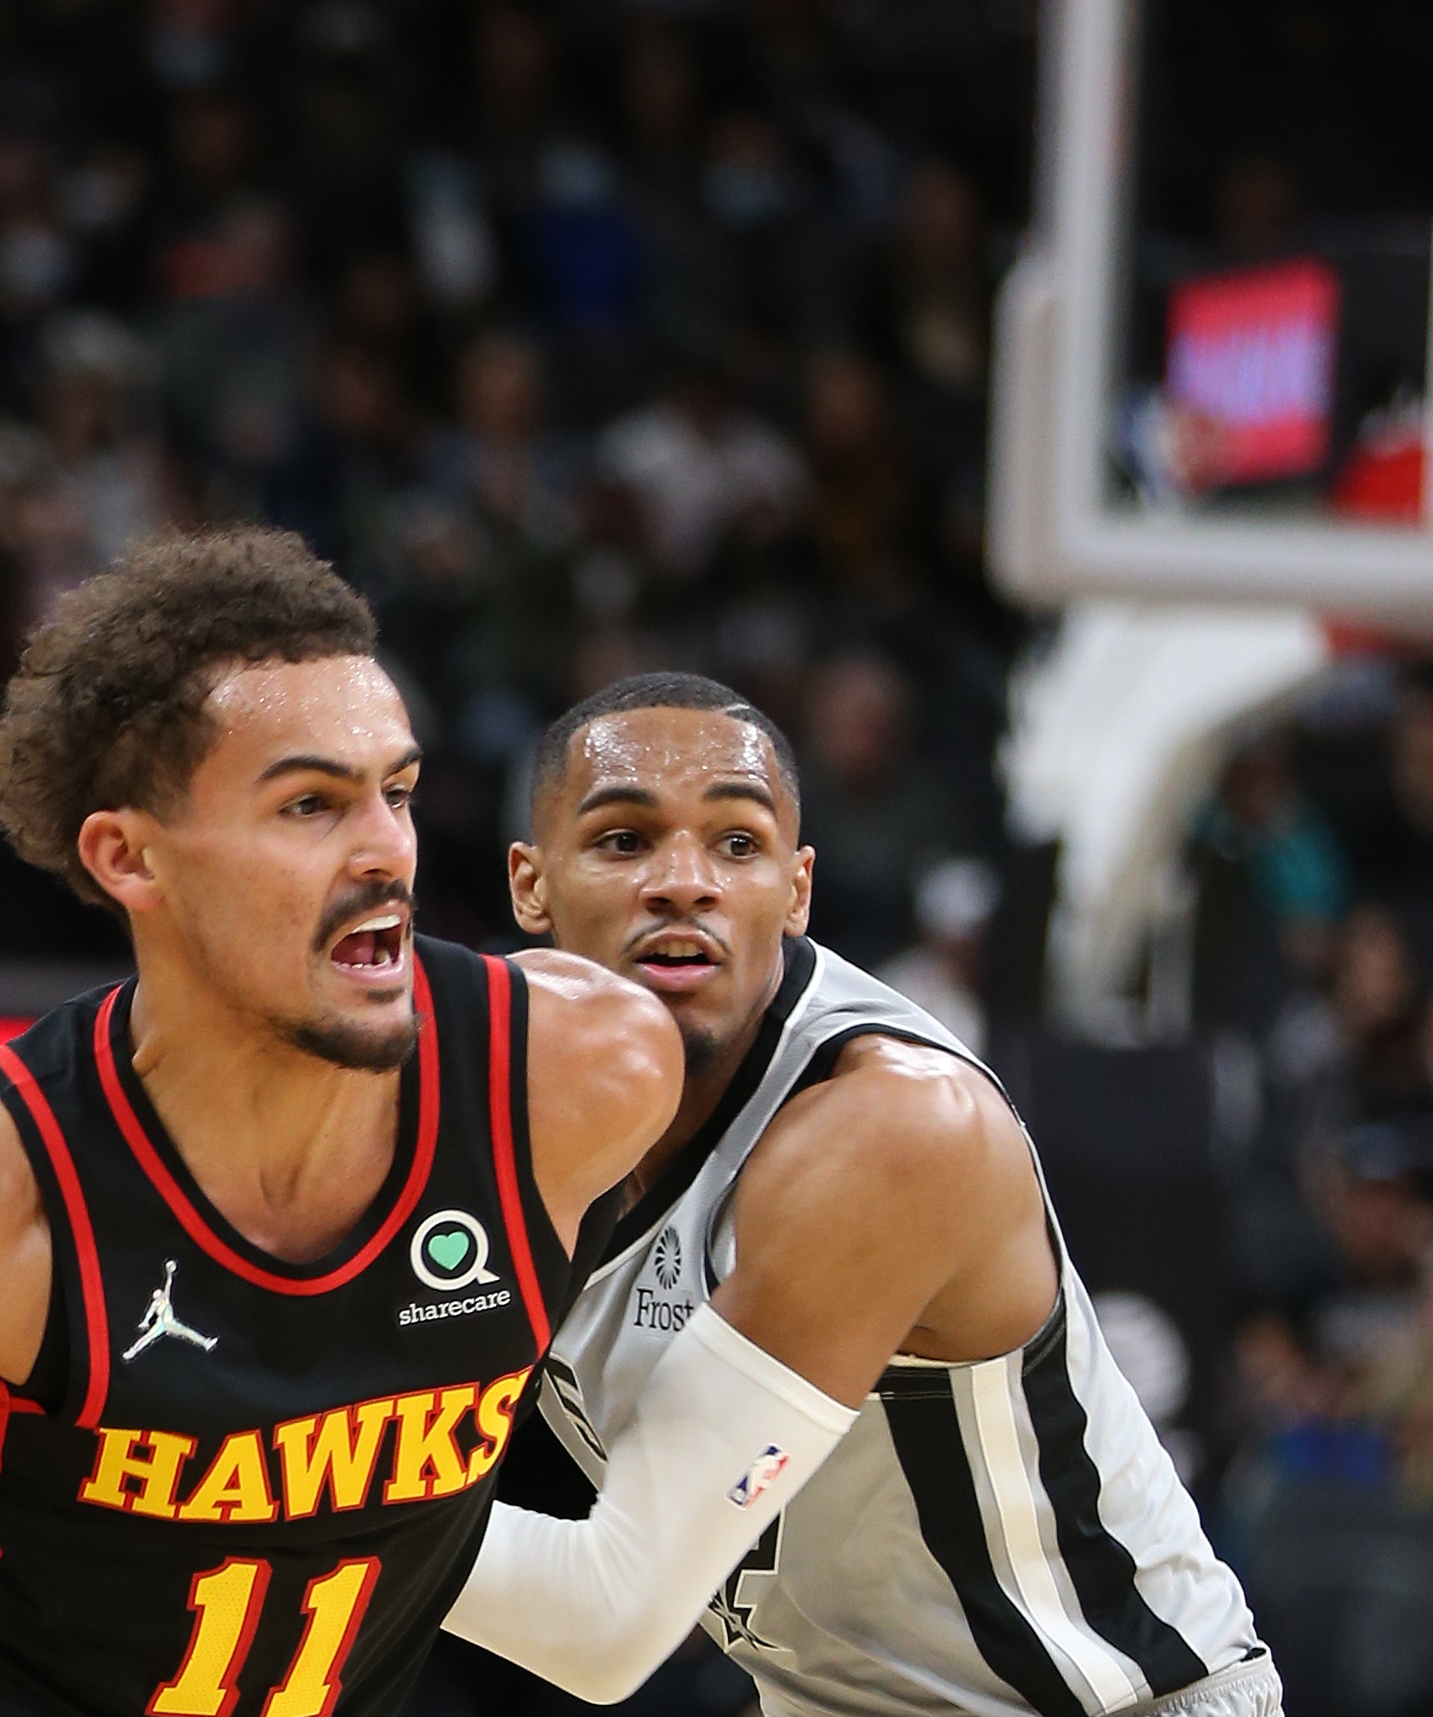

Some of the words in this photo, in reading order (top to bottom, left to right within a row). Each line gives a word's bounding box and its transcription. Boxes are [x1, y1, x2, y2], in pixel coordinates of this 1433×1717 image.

[398, 1289, 511, 1326] sharecare
[633, 1287, 694, 1332] Frost
[77, 1363, 534, 1525] HAWKS
